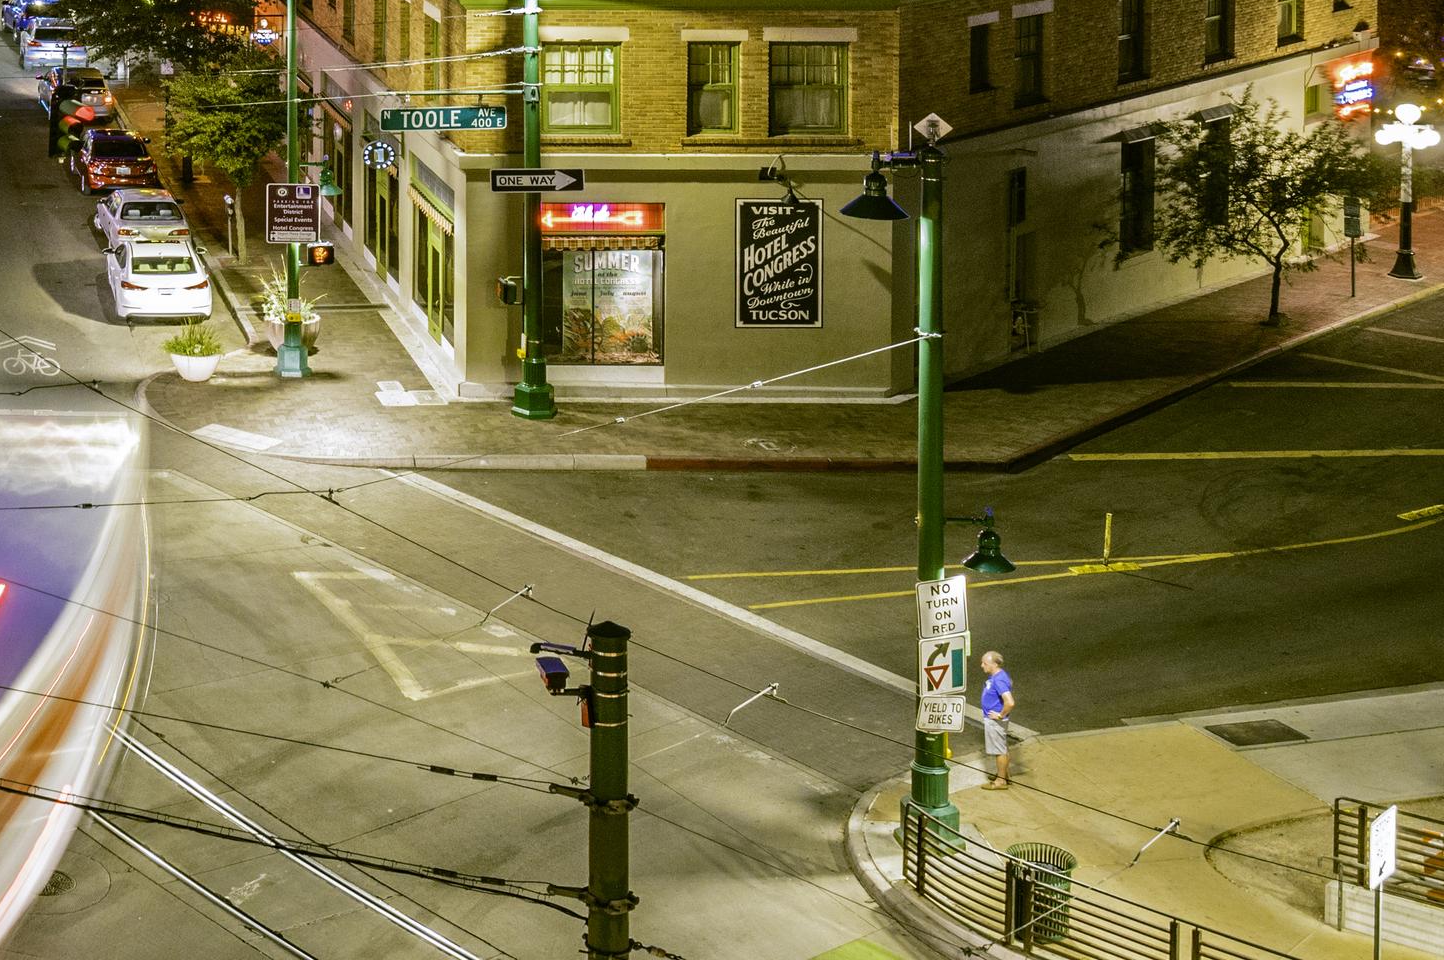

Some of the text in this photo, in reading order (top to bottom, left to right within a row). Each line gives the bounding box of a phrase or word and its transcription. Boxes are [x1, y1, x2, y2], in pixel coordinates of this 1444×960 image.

[384, 111, 391, 119] N
[478, 108, 496, 117] AVE
[400, 110, 462, 128] TOOLE
[471, 118, 503, 128] 400 E
[499, 176, 555, 186] ONE WAY
[751, 206, 794, 215] VISIT
[752, 217, 775, 230] The
[753, 217, 810, 240] Beautiful
[744, 234, 789, 273] HOTEL
[574, 252, 640, 273] SUMMER
[744, 236, 815, 296] CONGRESS
[760, 279, 795, 295] While
[747, 288, 814, 309] Downtown
[749, 310, 810, 321] TUCSON
[931, 584, 950, 595] NO
[926, 597, 958, 609] TURN
[936, 611, 951, 620] ON
[932, 622, 955, 634] RED
[924, 703, 962, 713] YIELD TO
[928, 714, 953, 724] BIKES
